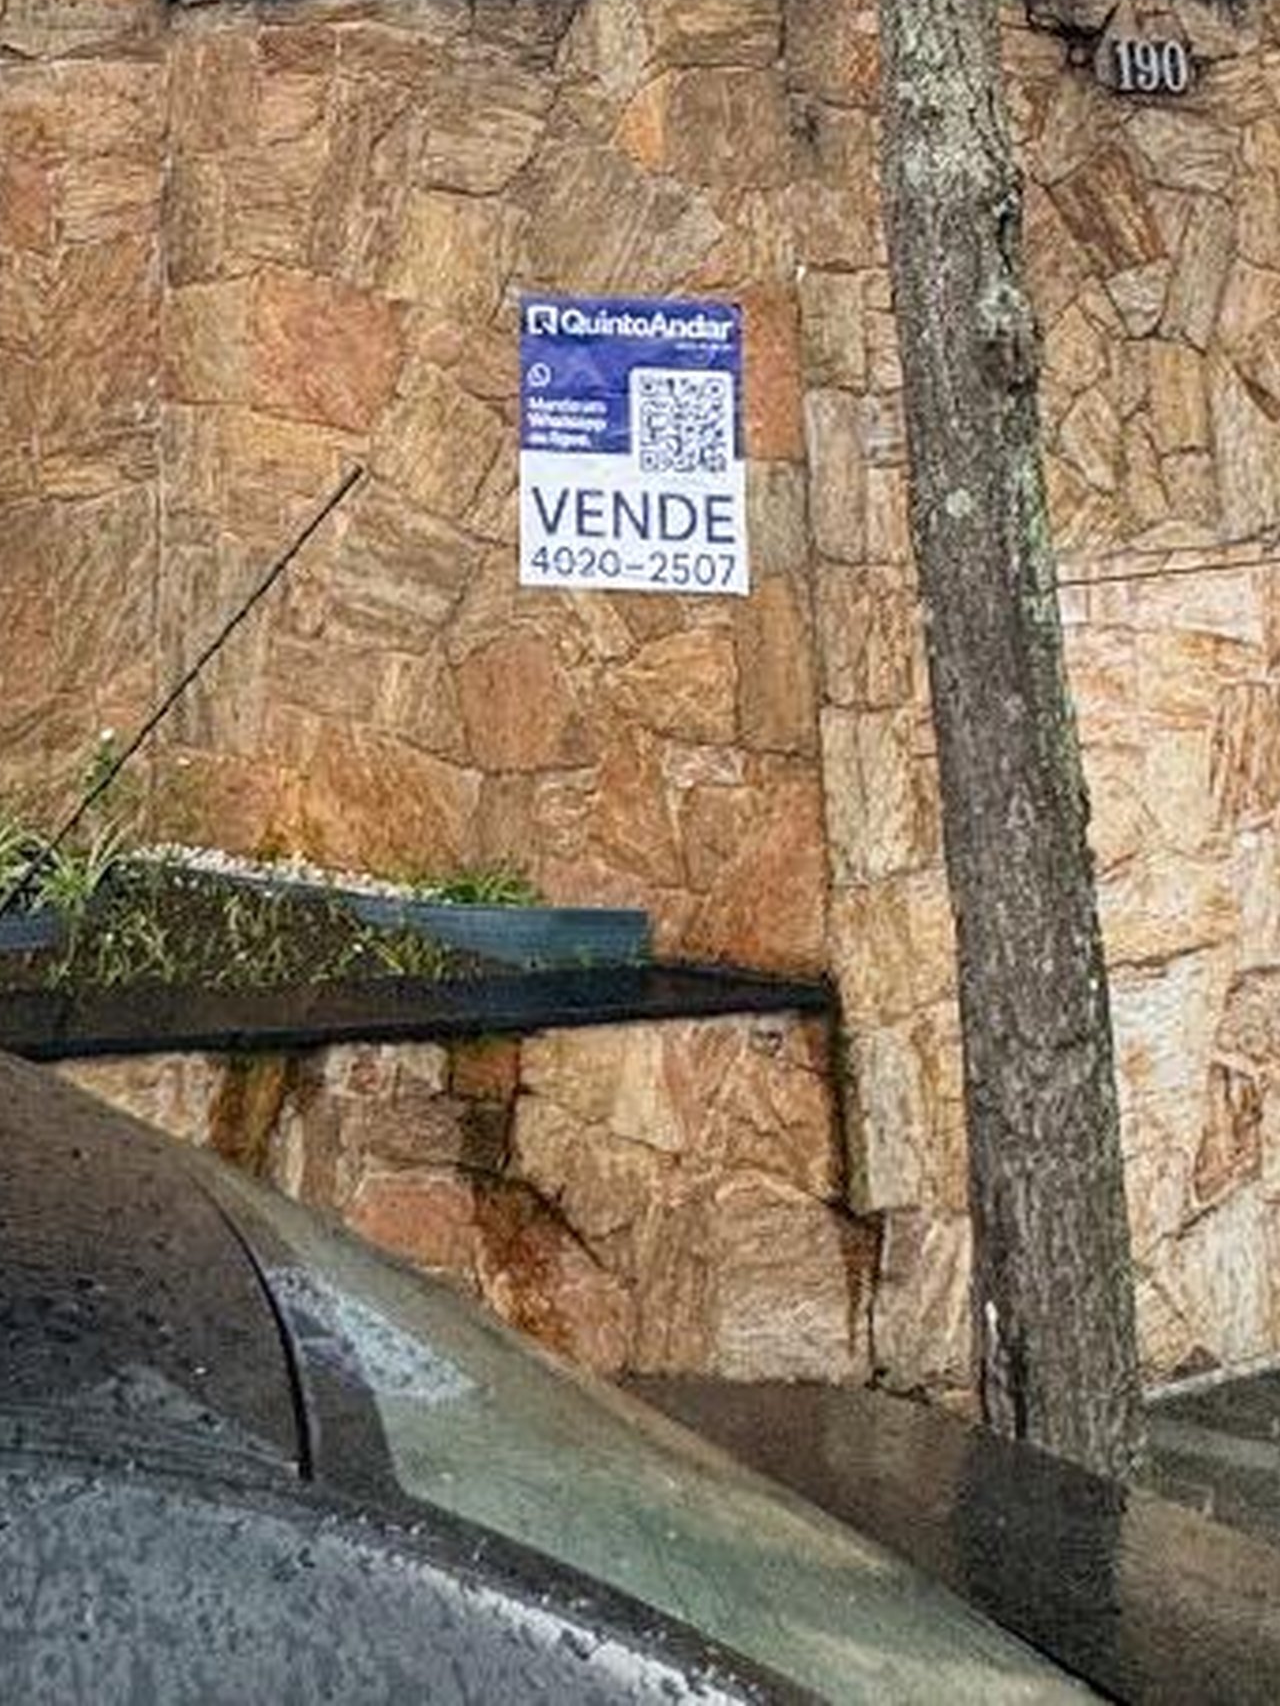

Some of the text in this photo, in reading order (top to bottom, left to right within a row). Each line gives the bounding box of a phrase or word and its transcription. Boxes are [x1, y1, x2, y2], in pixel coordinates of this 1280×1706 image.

[1117, 40, 1188, 92] 190
[561, 309, 733, 339] QuintoAndar
[532, 486, 735, 543] VENDE
[531, 546, 736, 586] 4020-2507
